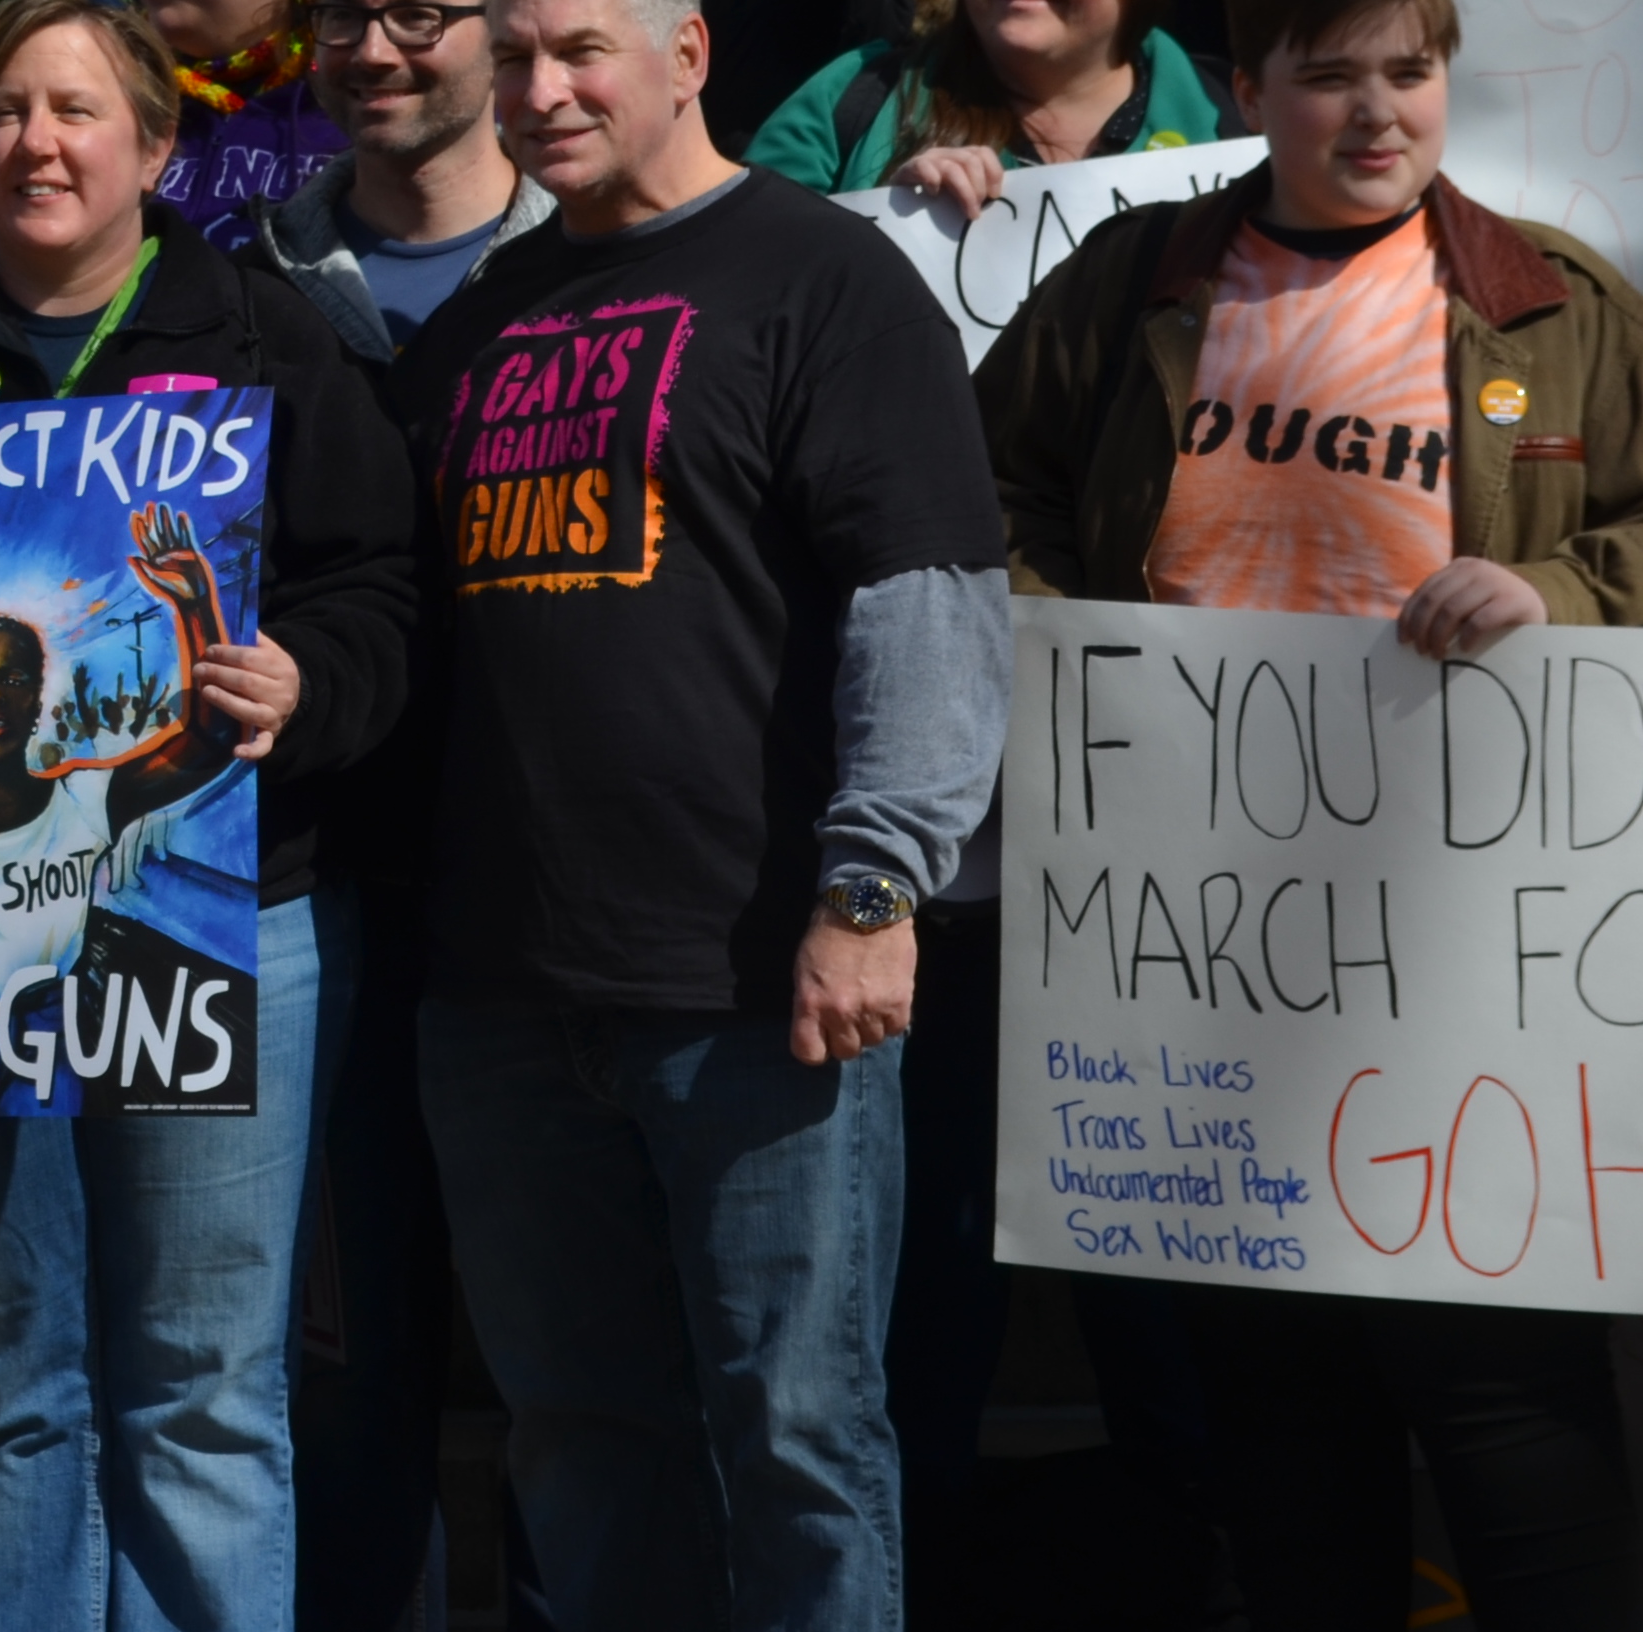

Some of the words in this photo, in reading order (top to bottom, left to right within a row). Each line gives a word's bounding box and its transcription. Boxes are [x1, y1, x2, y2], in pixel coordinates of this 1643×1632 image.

[481, 326, 644, 424] GAYS
[74, 400, 253, 506] KIDS
[465, 407, 619, 480] AGAINST
[457, 467, 611, 567] GUNS
[1050, 644, 1144, 836] IF
[1172, 653, 1381, 841] YOU
[1, 848, 97, 914] SHOOT
[1042, 866, 1400, 1022] MARCH
[1046, 1041, 1138, 1087] Black
[1160, 1044, 1256, 1093] Lives
[1052, 1099, 1147, 1152] Trans
[1164, 1106, 1258, 1154] Lives
[1049, 1156, 1224, 1209] Undocumented
[1240, 1158, 1312, 1220] People
[1067, 1210, 1143, 1257] Sex
[1156, 1220, 1308, 1272] Workers
